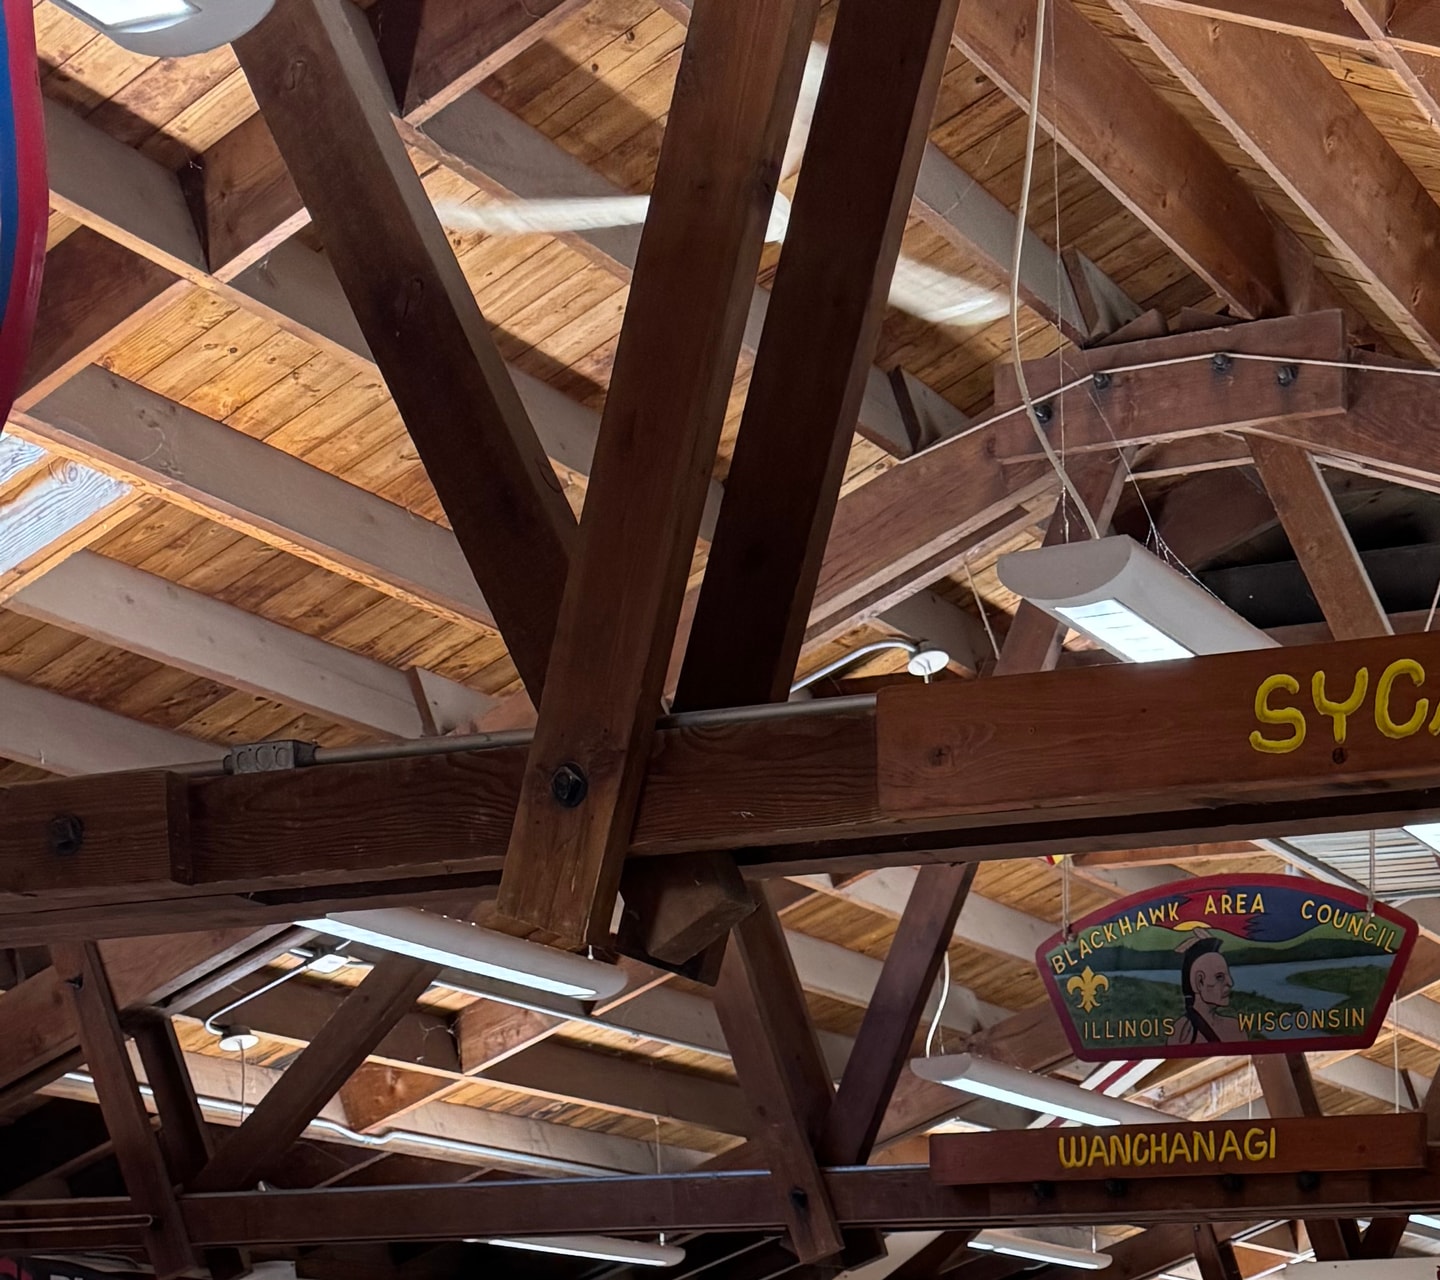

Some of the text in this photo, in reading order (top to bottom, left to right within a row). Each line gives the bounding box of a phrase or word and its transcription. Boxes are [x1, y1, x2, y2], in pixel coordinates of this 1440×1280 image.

[1050, 893, 1398, 975] BLACKHAWK AREA COUNCIL
[1083, 1007, 1366, 1040] ILLINOIS WISCONSIN
[1058, 1127, 1276, 1168] WANCHANAGI
